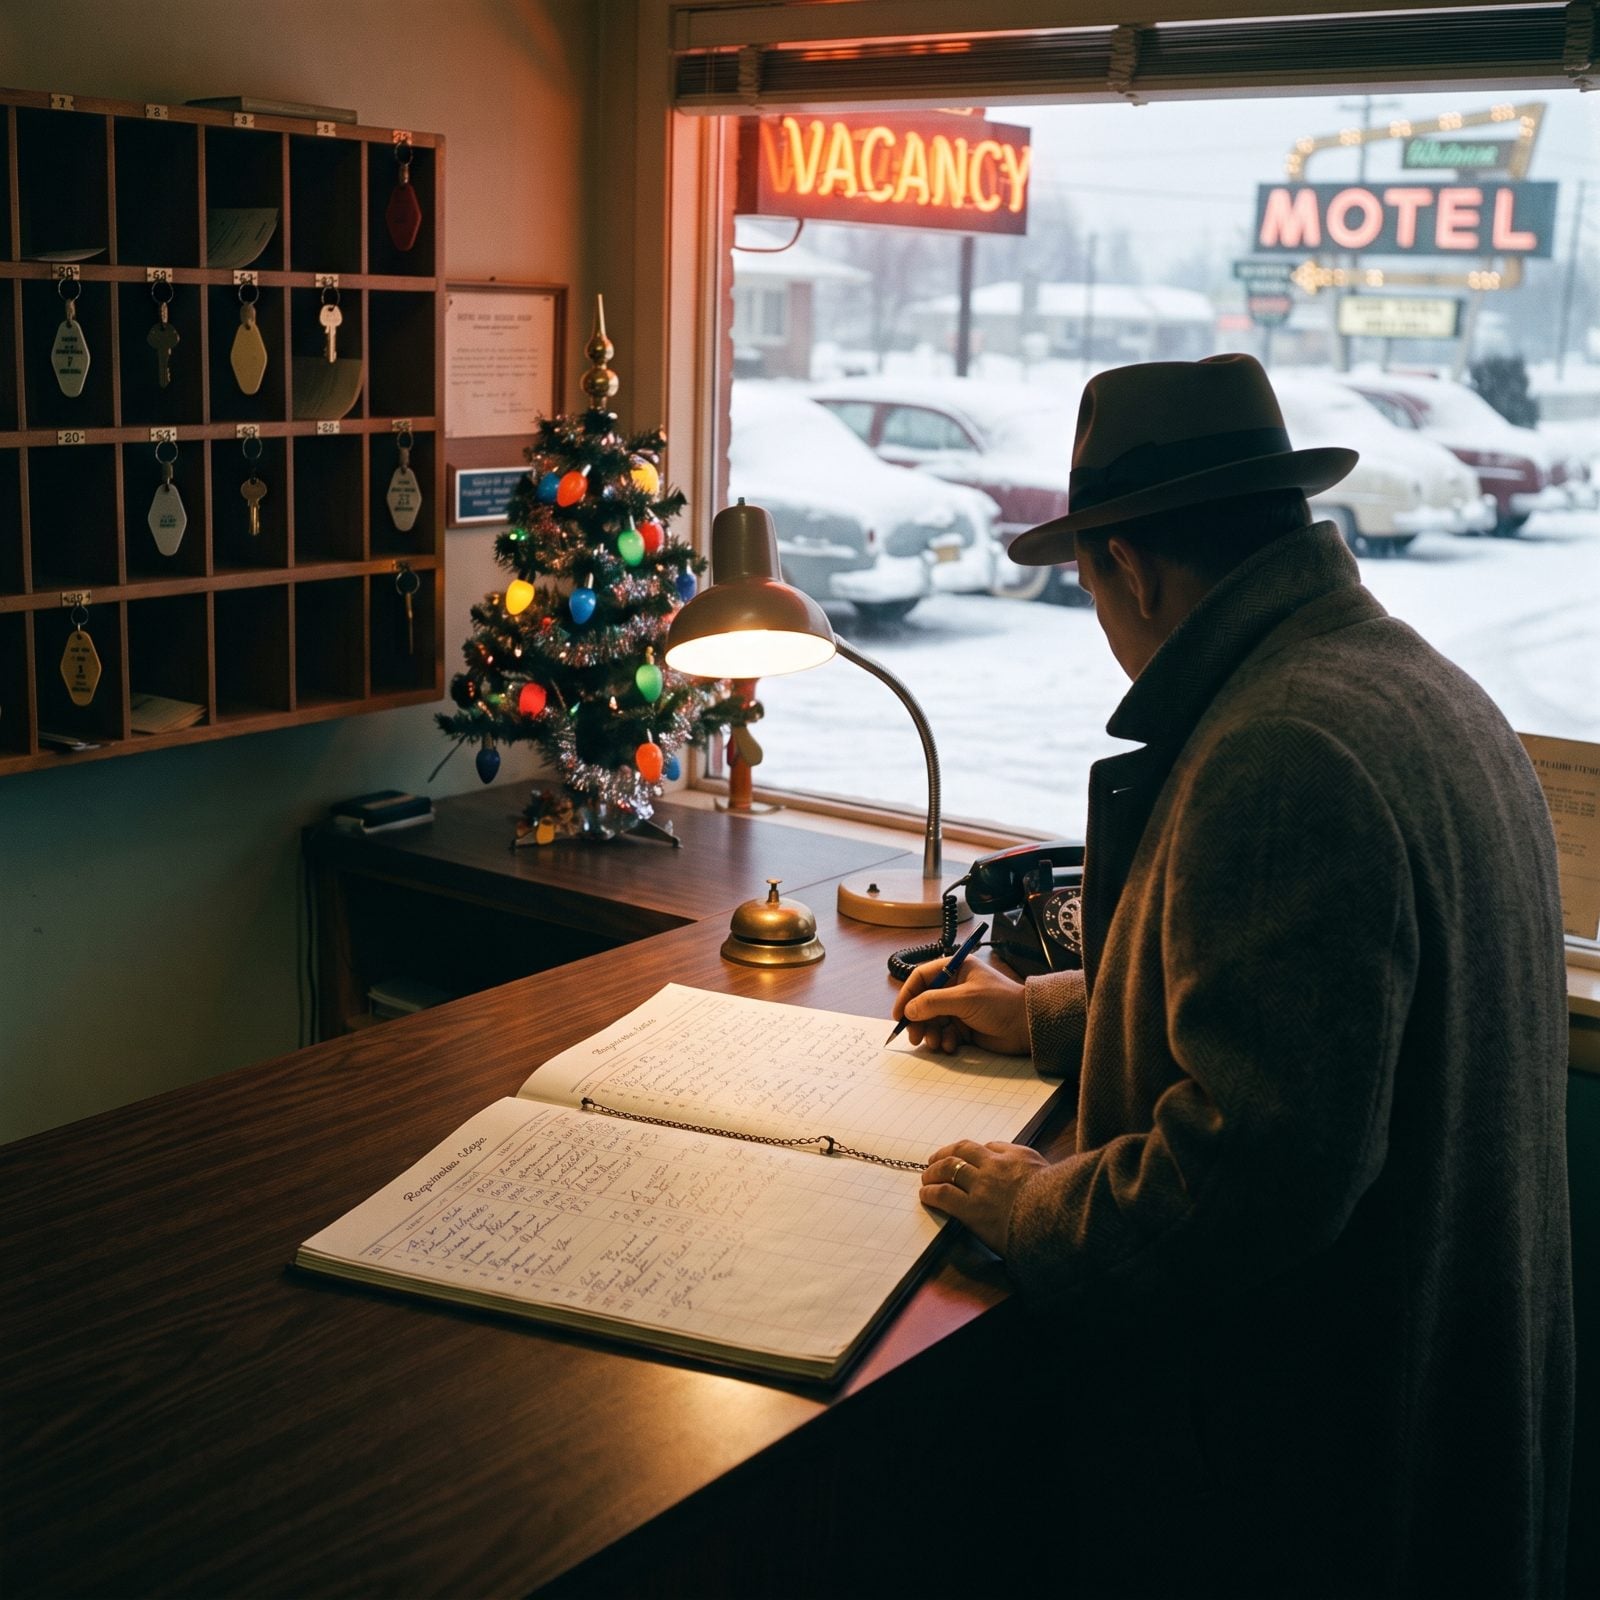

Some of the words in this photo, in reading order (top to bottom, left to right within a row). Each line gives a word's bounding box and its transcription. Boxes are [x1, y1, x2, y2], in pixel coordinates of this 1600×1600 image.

[783, 116, 1033, 213] VACANCY
[1259, 186, 1538, 250] MOTEL
[64, 432, 80, 443] 20
